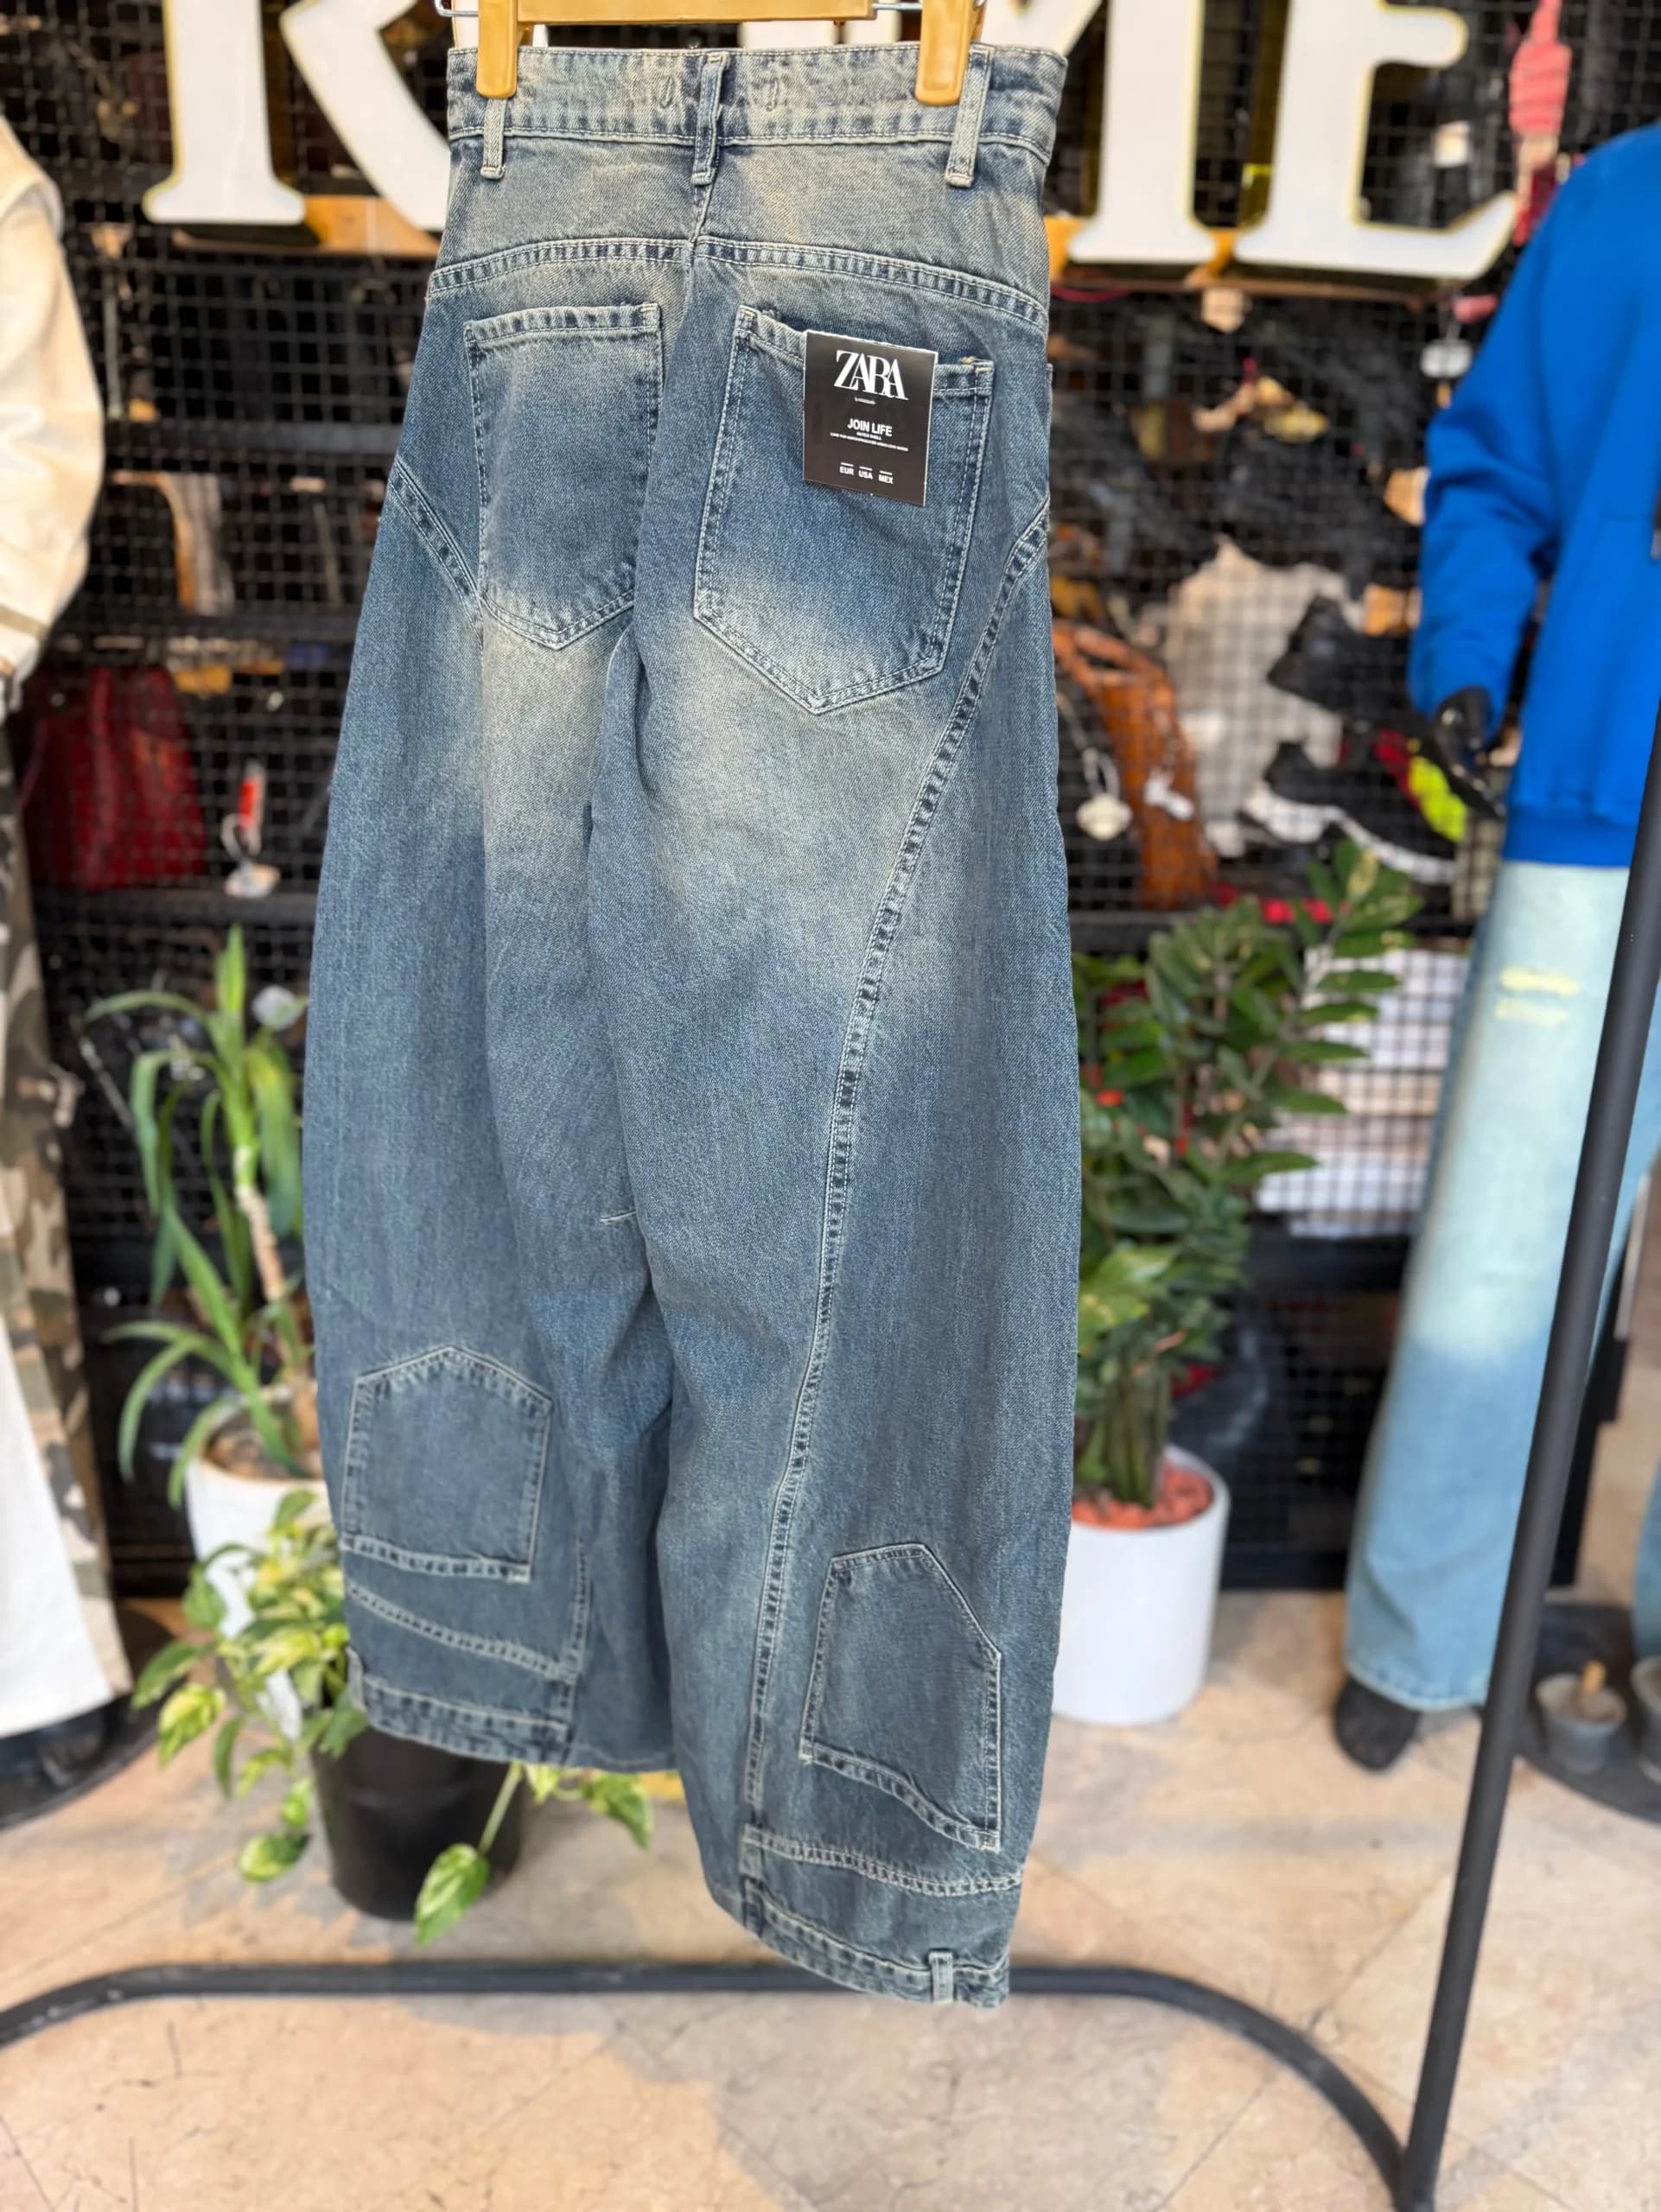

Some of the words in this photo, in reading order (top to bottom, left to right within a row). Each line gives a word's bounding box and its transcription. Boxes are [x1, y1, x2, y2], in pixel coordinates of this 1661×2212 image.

[834, 350, 909, 401] ZARA
[847, 418, 869, 433] JOIN
[871, 423, 893, 437] LIFE
[839, 466, 855, 476] EUR
[858, 469, 874, 480] USA
[878, 474, 894, 485] MEX
